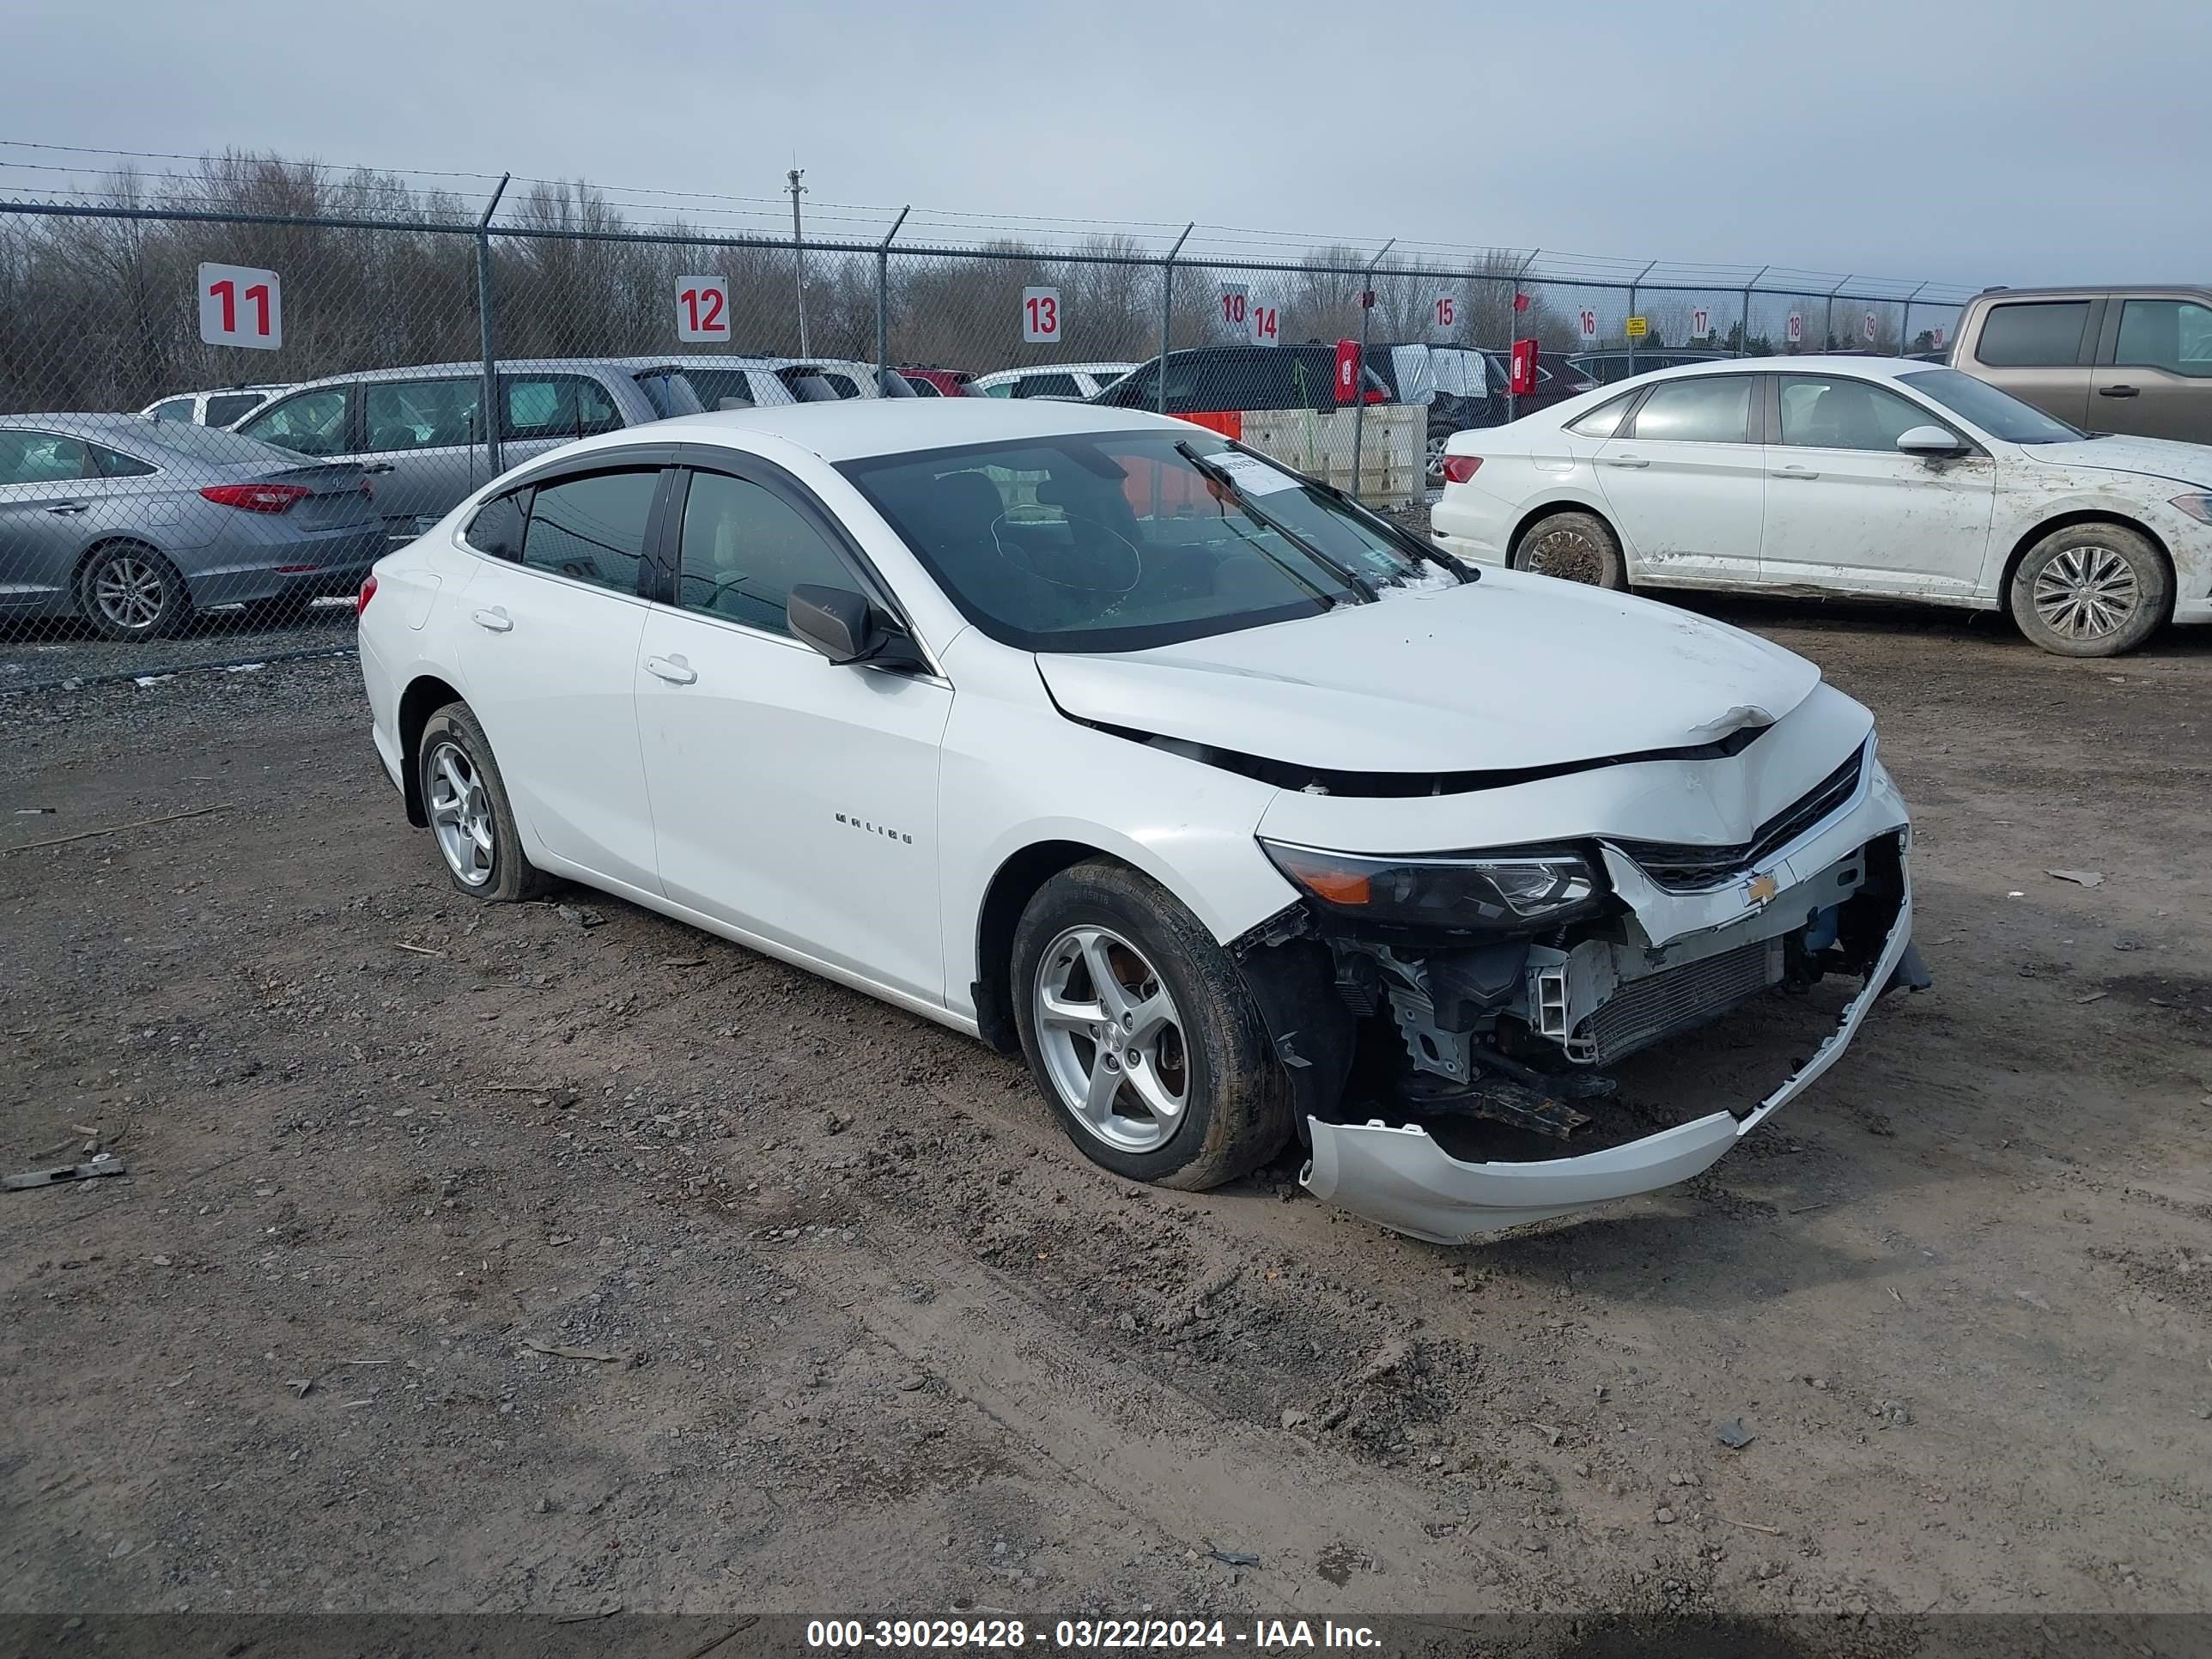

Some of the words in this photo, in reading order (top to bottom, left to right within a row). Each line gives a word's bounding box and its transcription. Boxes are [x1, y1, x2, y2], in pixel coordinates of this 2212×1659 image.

[210, 281, 270, 336] 11
[682, 289, 724, 331] 12
[1027, 298, 1056, 333] 13
[1222, 294, 1245, 323] 10
[1254, 307, 1277, 339] 14
[1436, 298, 1454, 326] 15
[1580, 311, 1595, 335] 16
[1694, 311, 1707, 333] 17
[1790, 317, 1801, 337] 18
[1866, 315, 1875, 337] 19
[835, 811, 912, 844] MALIBU
